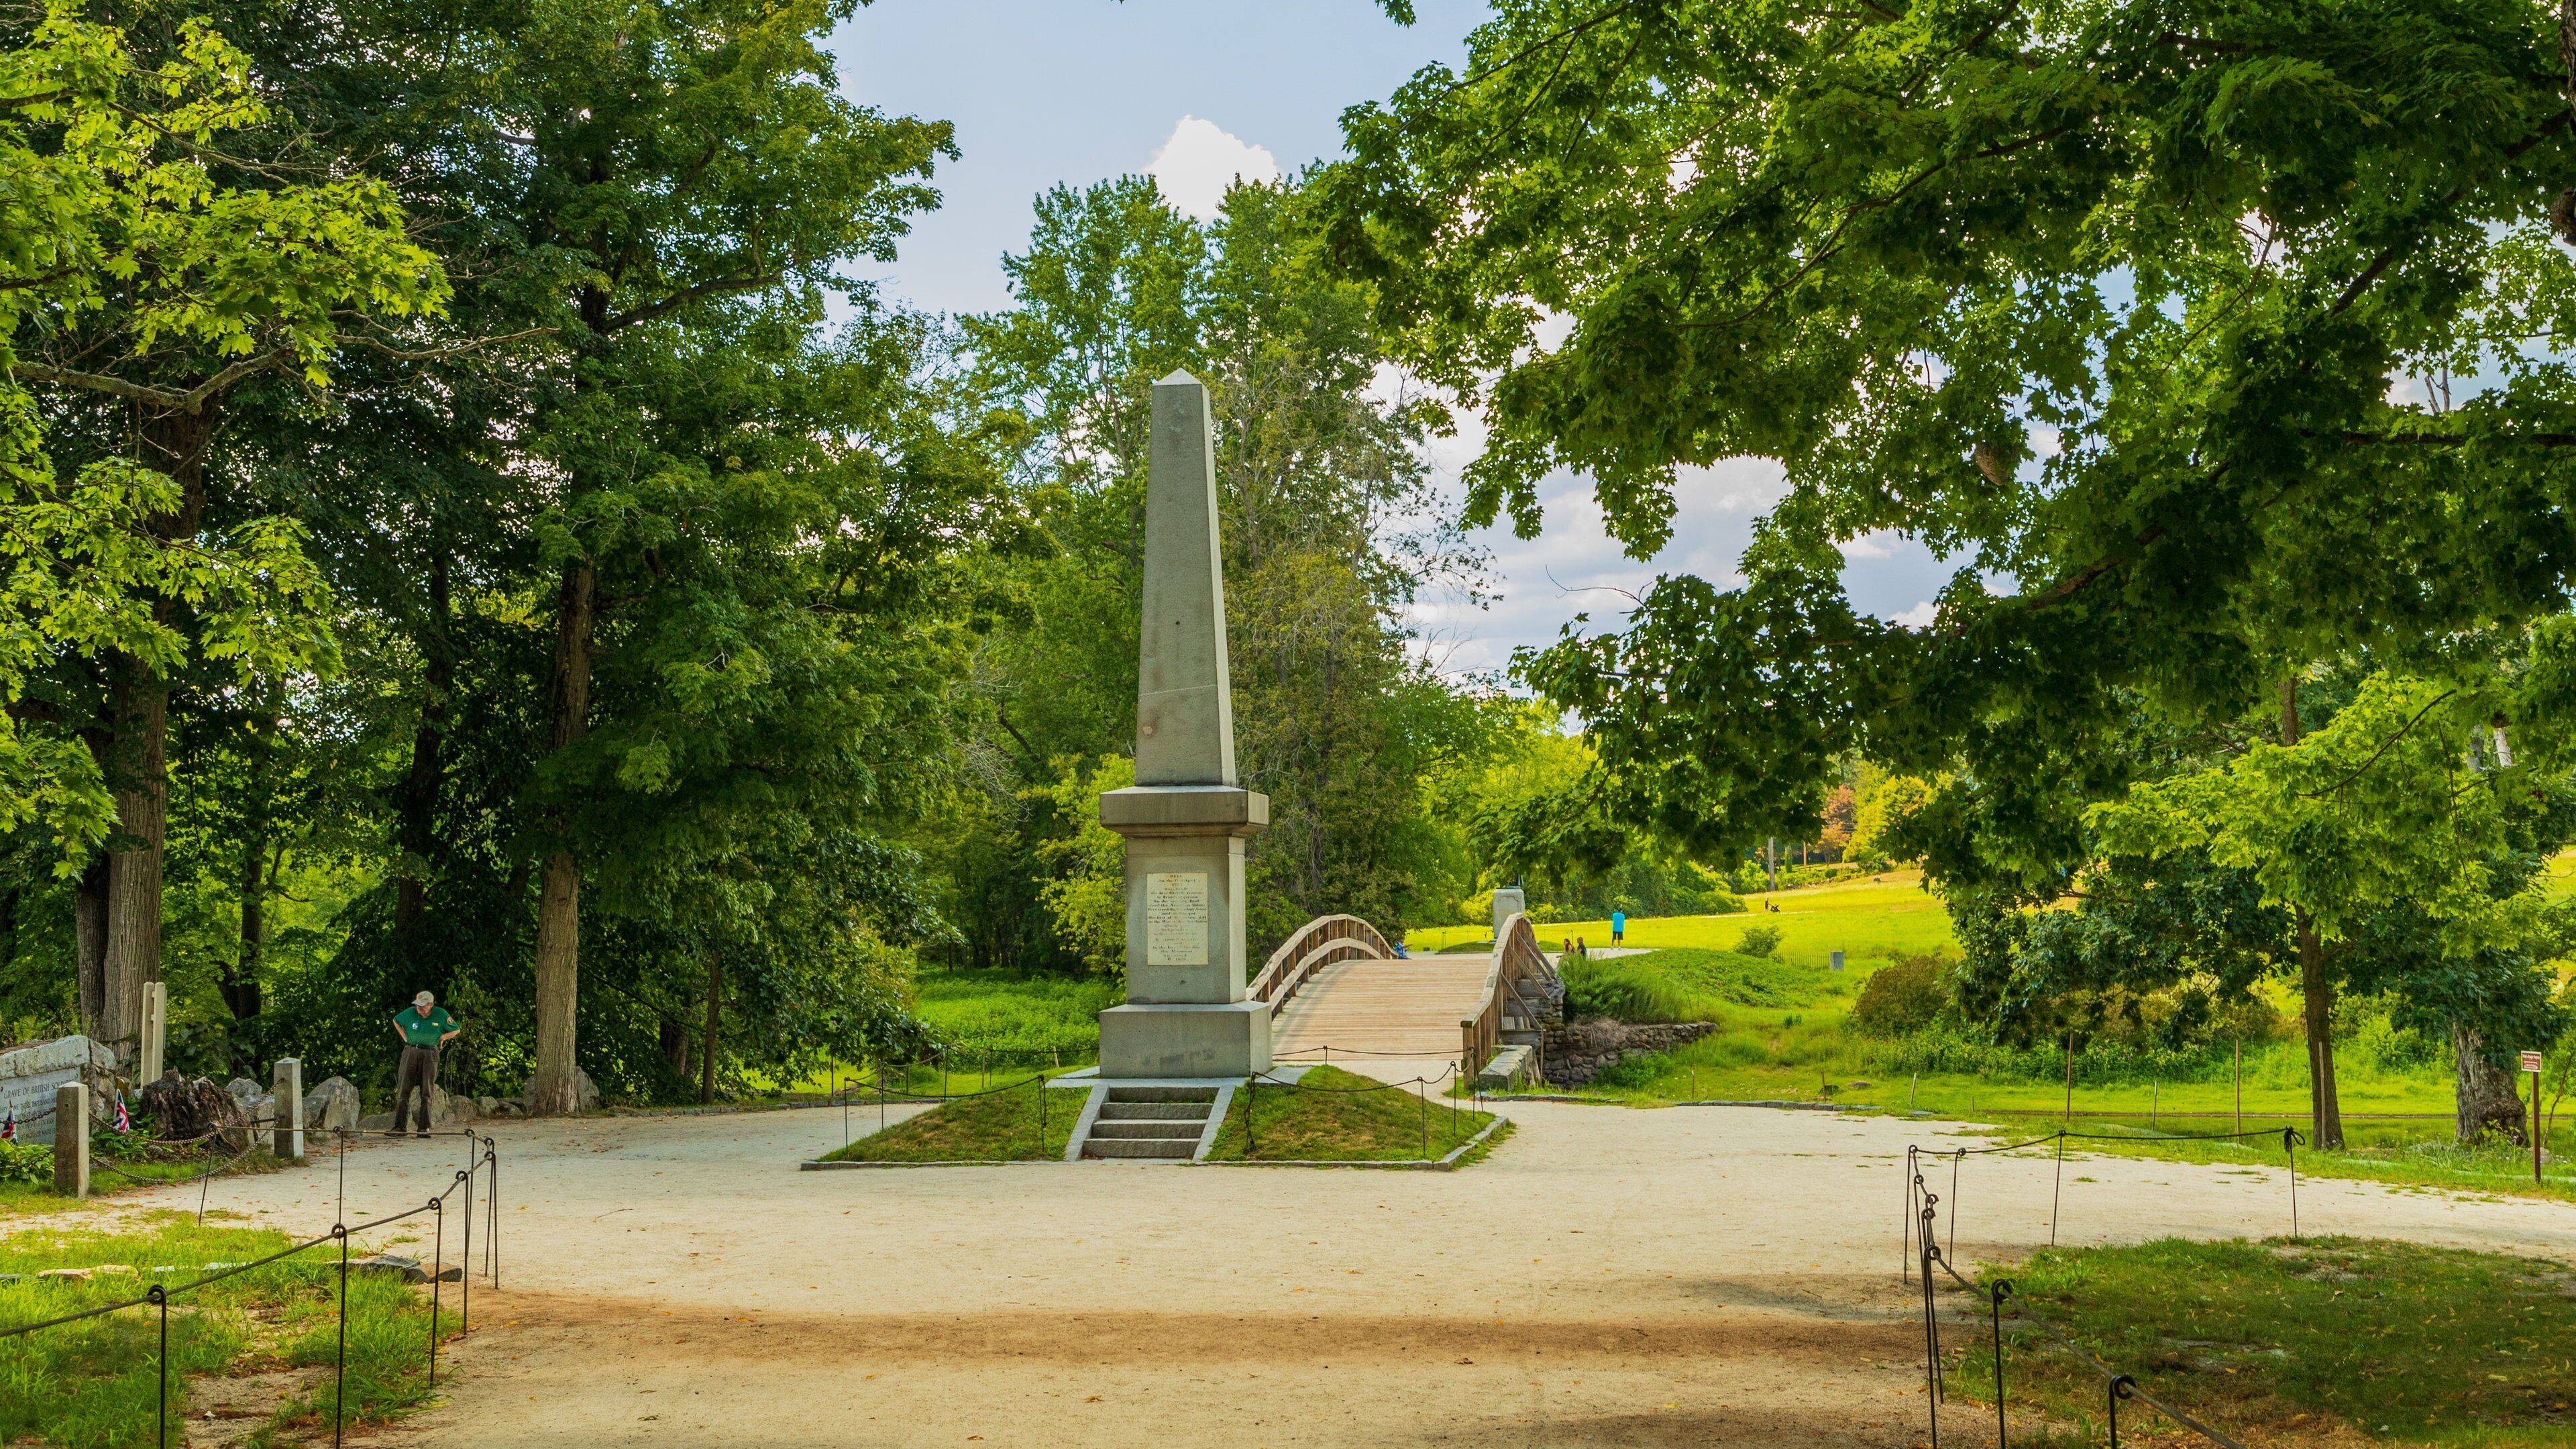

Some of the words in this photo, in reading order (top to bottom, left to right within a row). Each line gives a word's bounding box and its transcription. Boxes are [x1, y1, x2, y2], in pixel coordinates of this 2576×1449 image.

[4, 1088, 21, 1099] GRAVE
[23, 1087, 30, 1095] OF
[31, 1083, 50, 1094] BRITISH
